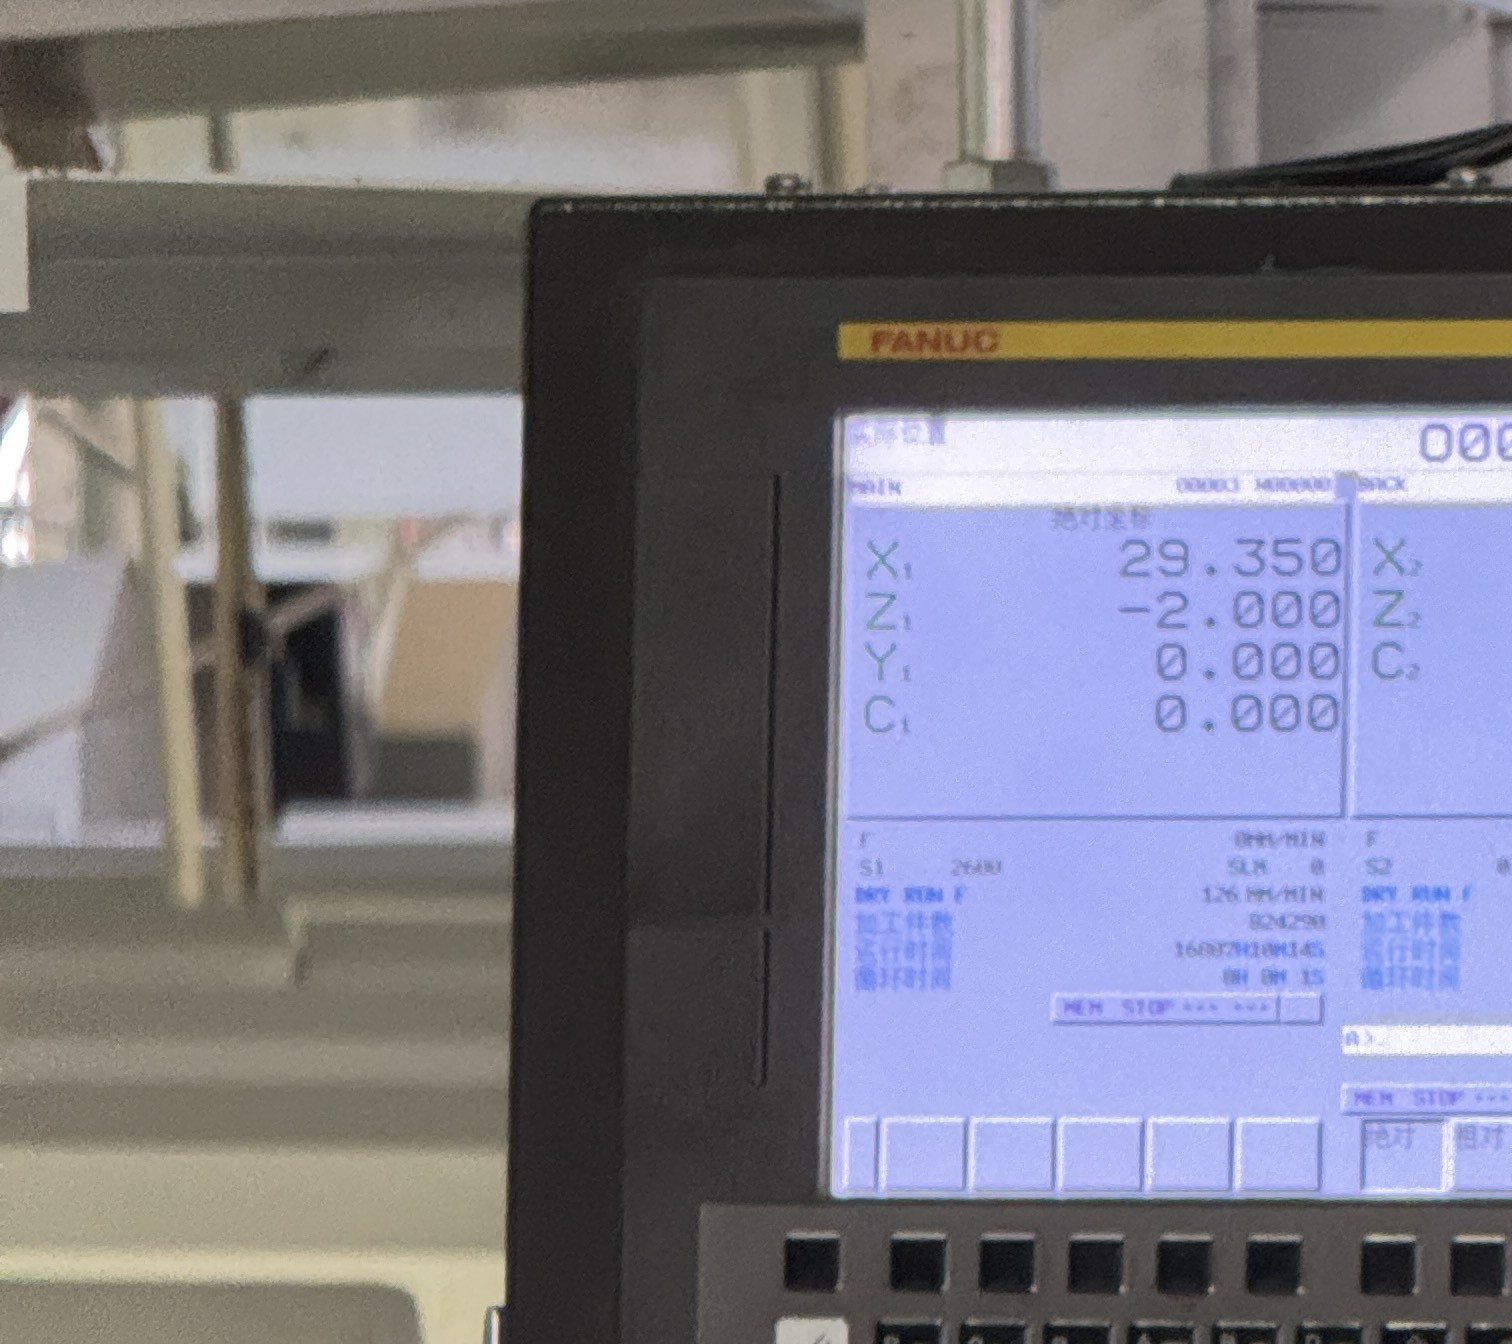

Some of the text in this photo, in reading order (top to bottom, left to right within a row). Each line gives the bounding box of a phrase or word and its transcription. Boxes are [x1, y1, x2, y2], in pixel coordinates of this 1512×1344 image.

[869, 327, 1000, 355] FANUC
[1117, 537, 1343, 578] 29.350
[1117, 589, 1342, 630] -2.000
[1156, 641, 1341, 682] 0.000
[1155, 693, 1340, 734] 0.000
